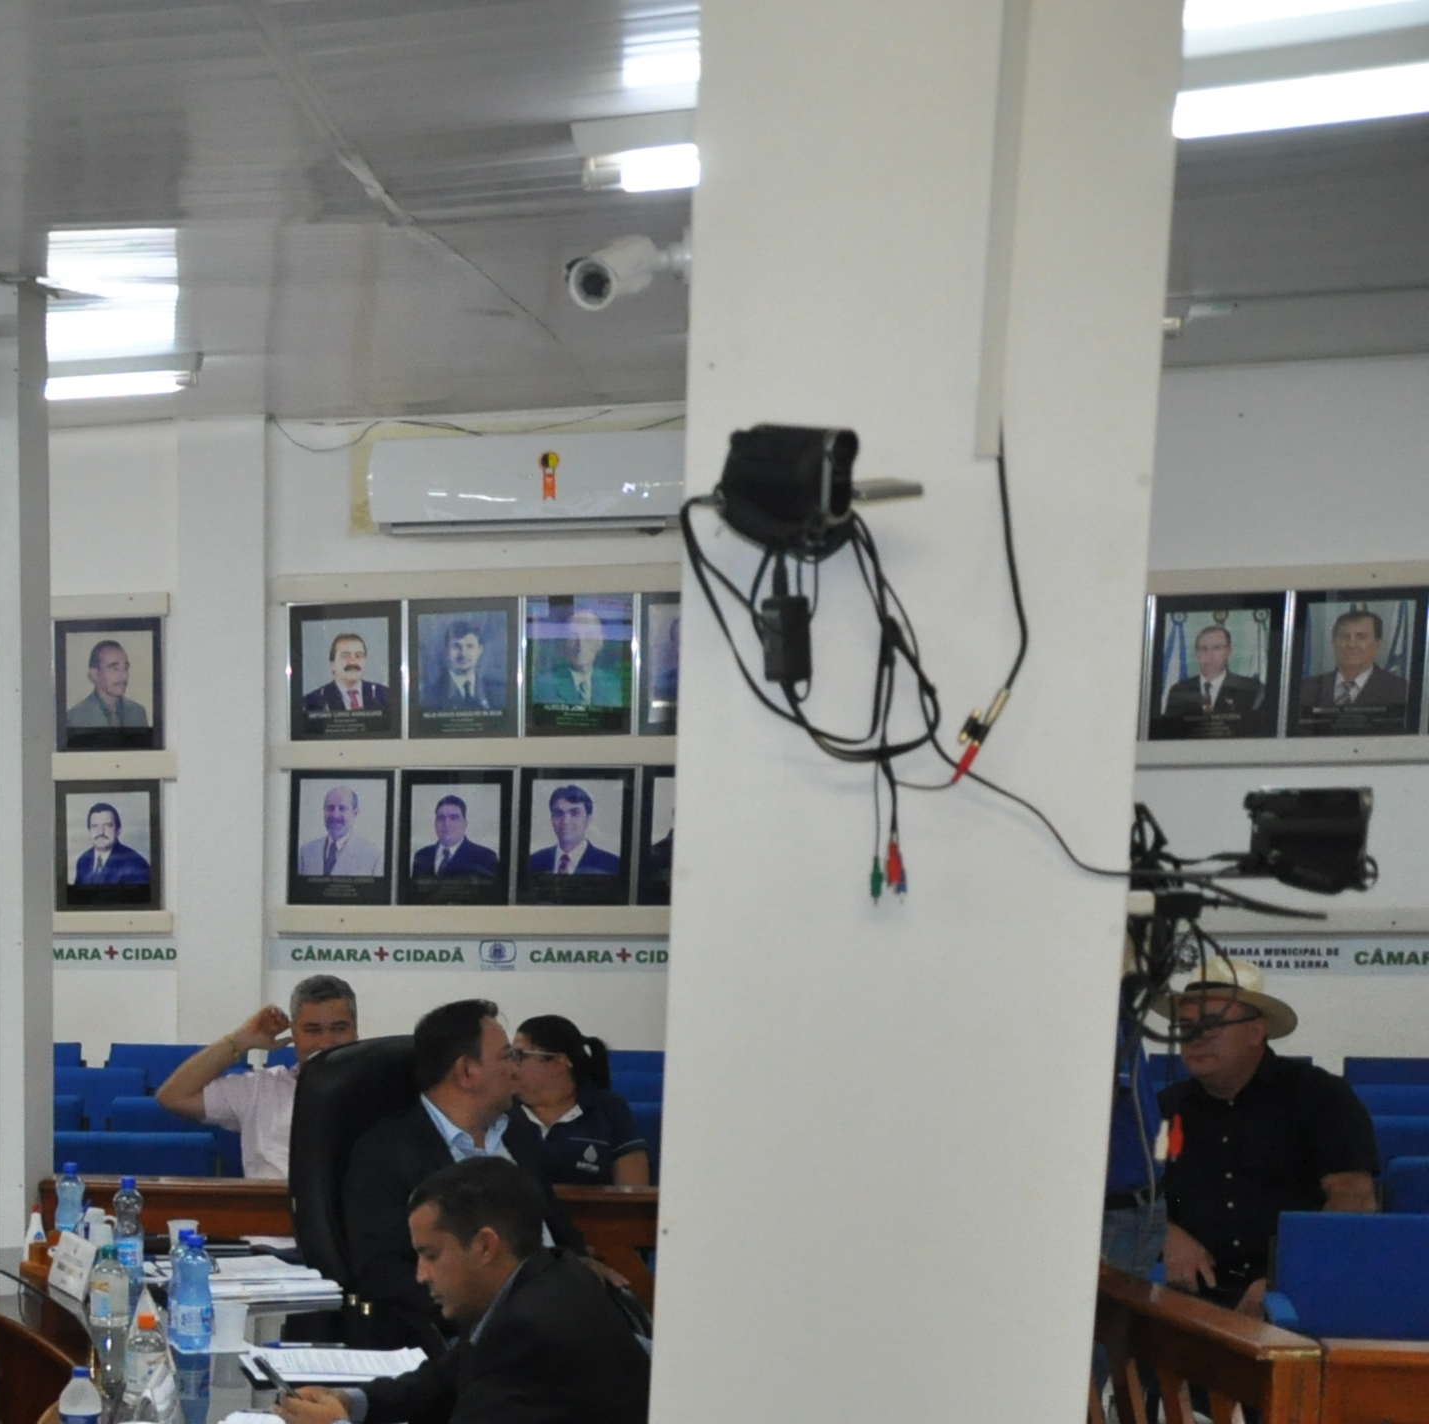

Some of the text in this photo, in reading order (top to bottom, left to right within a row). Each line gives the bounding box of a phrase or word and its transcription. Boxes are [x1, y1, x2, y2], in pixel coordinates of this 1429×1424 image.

[291, 946, 372, 962] CÂMARA
[392, 947, 465, 963] CIDADÃ
[529, 947, 613, 963] CÂMARA
[1264, 948, 1322, 957] MUNICIPAL
[1326, 948, 1340, 957] DE
[1294, 960, 1329, 969] SERRA
